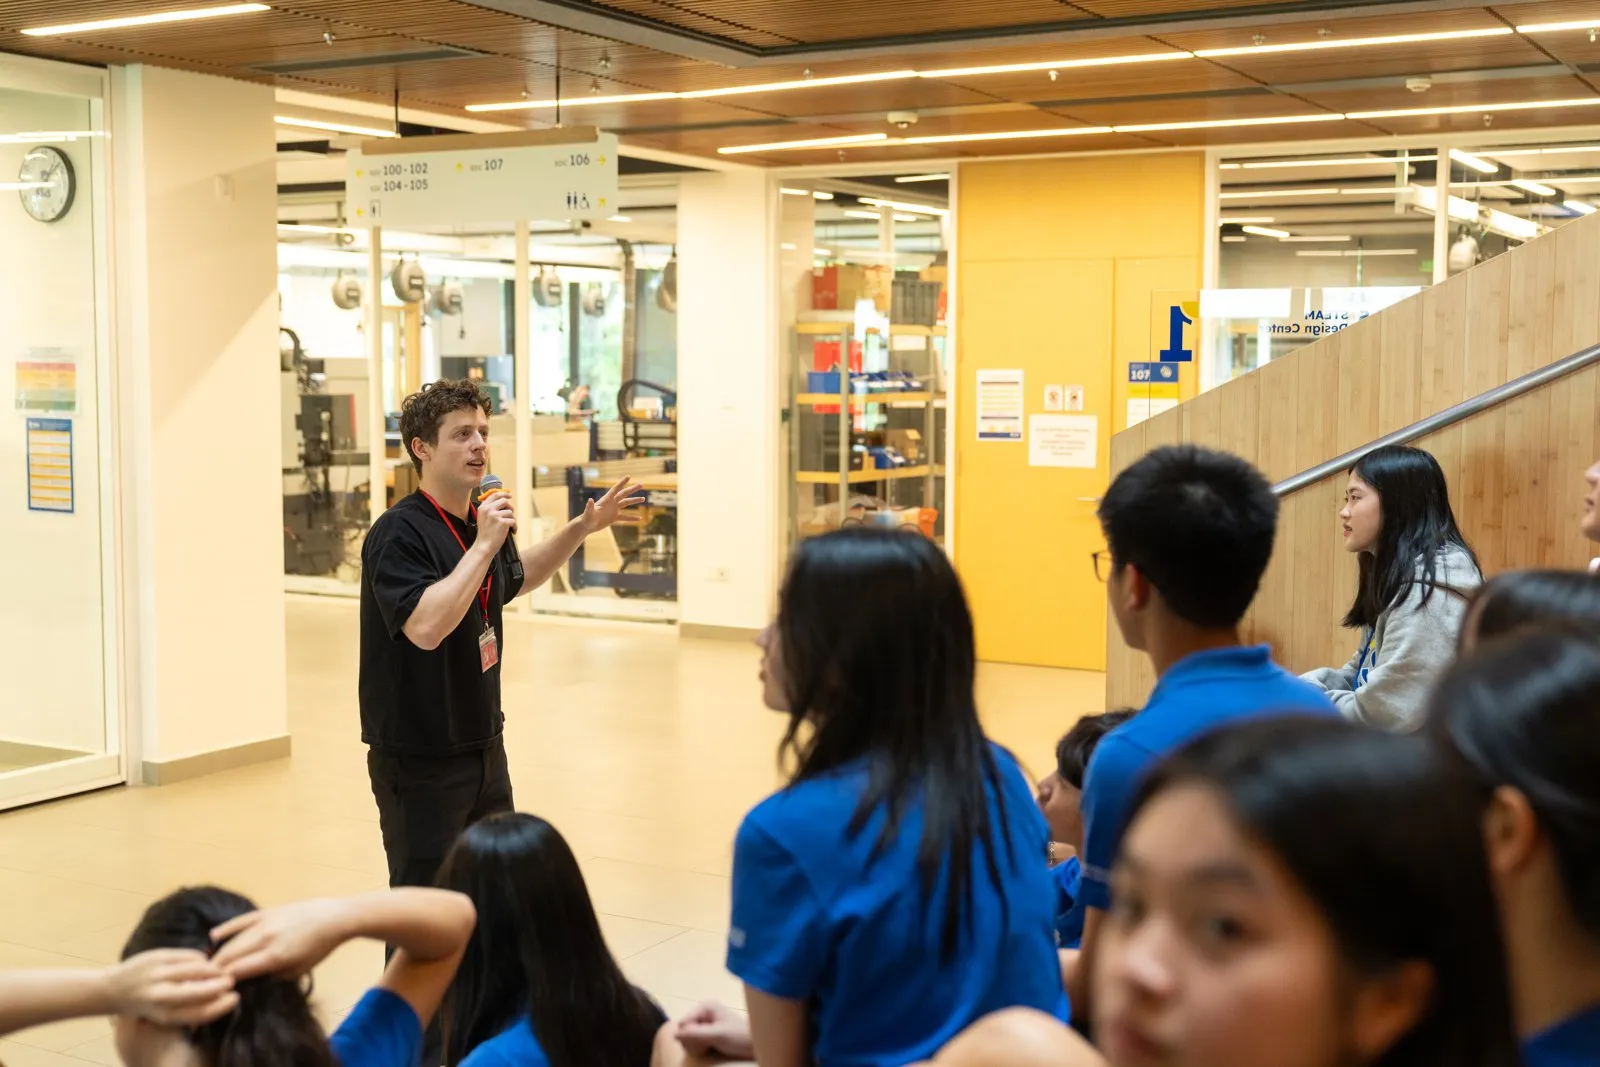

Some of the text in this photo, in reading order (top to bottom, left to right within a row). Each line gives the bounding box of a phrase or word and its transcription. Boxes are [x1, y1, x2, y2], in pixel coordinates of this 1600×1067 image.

[485, 158, 503, 171] 107
[570, 153, 590, 166] 106
[384, 164, 402, 176] 100
[410, 162, 428, 175] 102
[384, 180, 402, 192] 104
[410, 179, 429, 191] 105
[1131, 369, 1150, 381] 107
